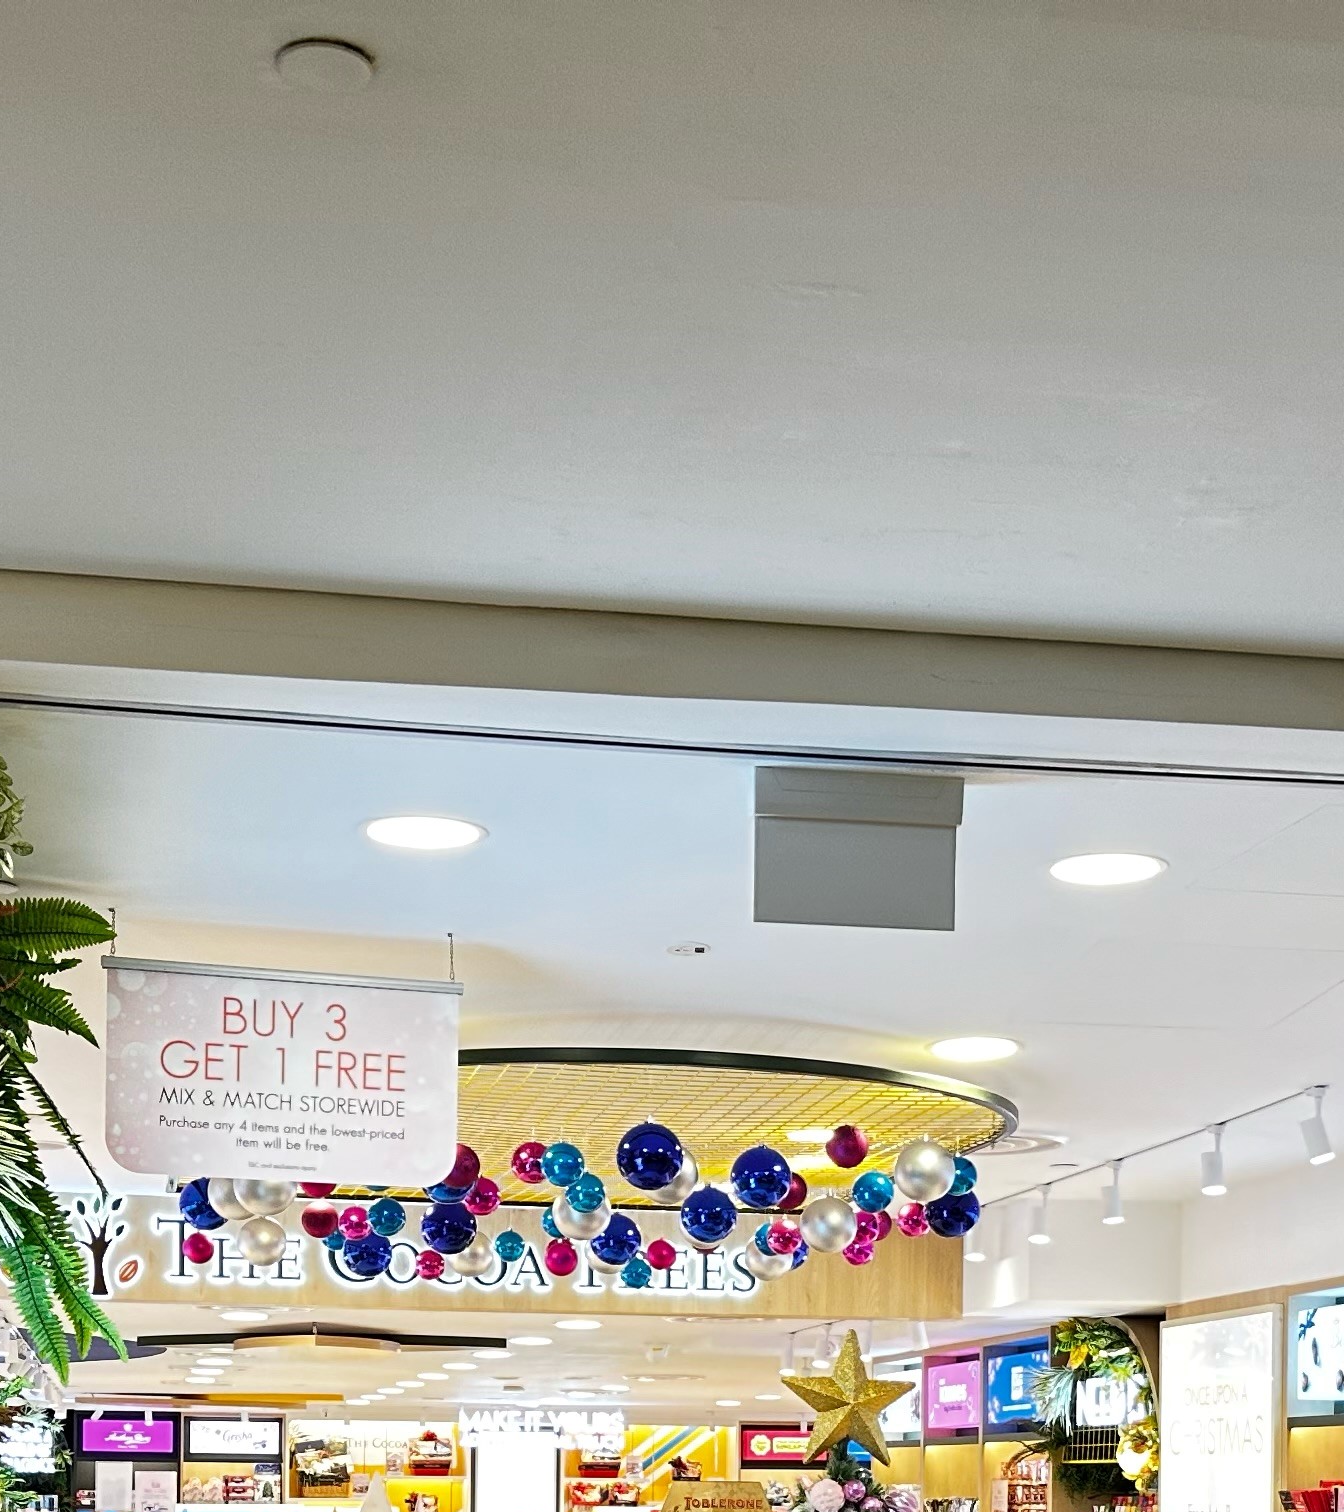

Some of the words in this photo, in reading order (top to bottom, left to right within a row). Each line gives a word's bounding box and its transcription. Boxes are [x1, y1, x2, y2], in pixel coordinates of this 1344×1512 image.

[223, 996, 304, 1039] BUY
[325, 1004, 347, 1041] 3
[160, 1040, 248, 1082] GET
[276, 1047, 286, 1085] 1
[315, 1050, 406, 1092] FREE
[158, 1087, 195, 1106] MIX
[202, 1090, 215, 1106] &
[223, 1091, 292, 1112] MATCH
[299, 1095, 406, 1118] STOREWIDE
[158, 1115, 210, 1130] Purchase
[214, 1121, 234, 1133] any
[239, 1120, 248, 1132] 4
[251, 1122, 279, 1134] items
[283, 1123, 305, 1135] and
[309, 1124, 328, 1136] the
[331, 1127, 405, 1142] lowest-priced
[236, 1137, 259, 1148] item
[263, 1138, 281, 1149] will
[286, 1139, 302, 1151] be
[305, 1140, 330, 1152] free.
[1183, 1385, 1210, 1406] ONCE
[1213, 1384, 1238, 1405] UPON
[1169, 1414, 1264, 1456] CHRISTMAS
[684, 1496, 763, 1511] TOBLERONE
